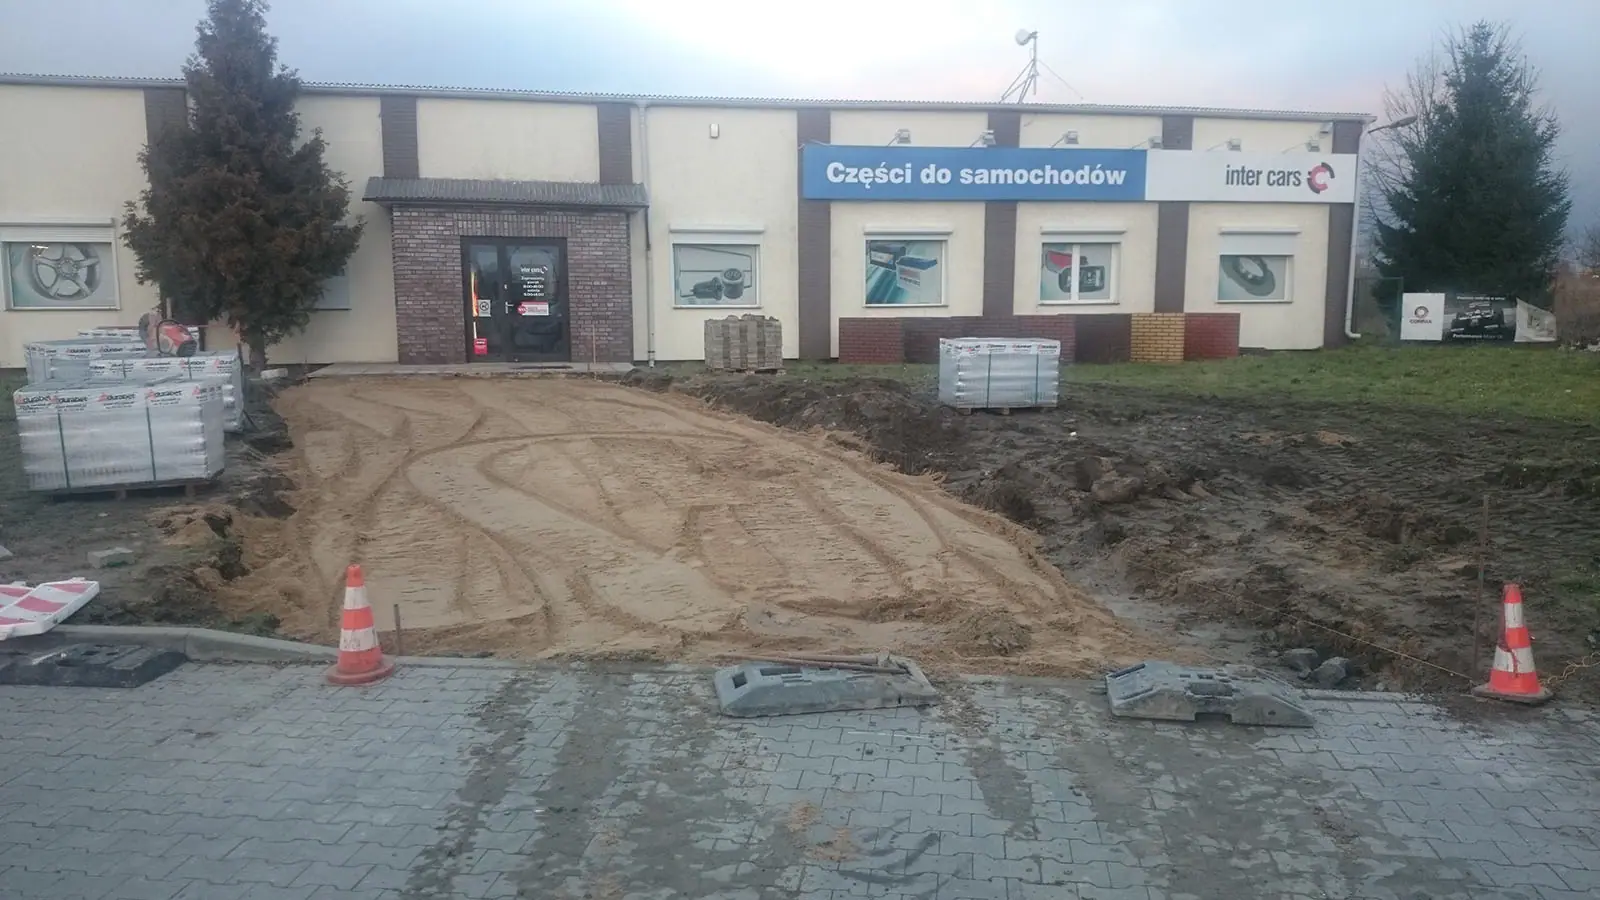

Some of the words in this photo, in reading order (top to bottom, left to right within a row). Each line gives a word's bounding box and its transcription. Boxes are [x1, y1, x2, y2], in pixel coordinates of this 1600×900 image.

[826, 161, 912, 189] Części
[920, 163, 952, 184] do
[959, 164, 1127, 185] samochodów
[1225, 164, 1263, 186] inter
[1267, 169, 1302, 187] cars
